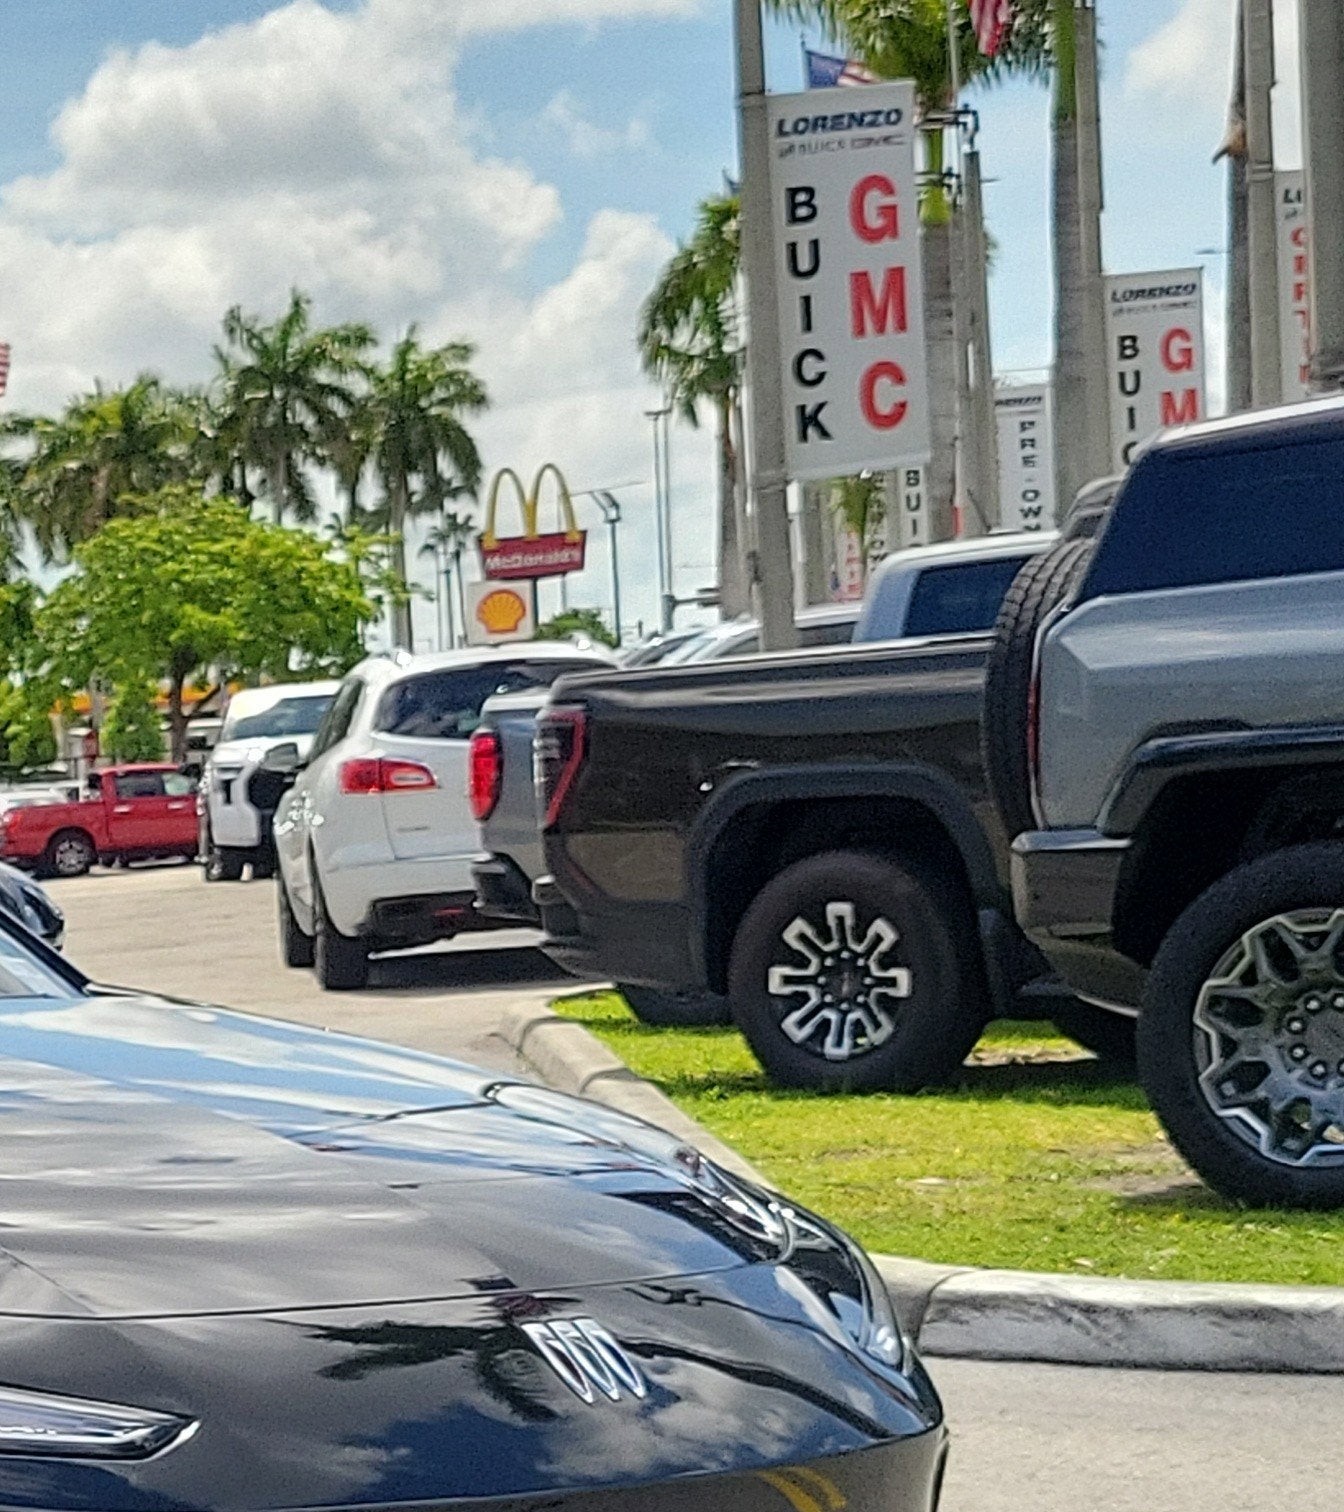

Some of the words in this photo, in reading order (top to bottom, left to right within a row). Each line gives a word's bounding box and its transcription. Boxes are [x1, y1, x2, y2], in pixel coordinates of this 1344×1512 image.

[777, 108, 903, 137] LORENZO
[785, 186, 833, 443] BUICK
[849, 174, 908, 430] GMC
[1111, 283, 1197, 303] LORENZO
[1117, 335, 1141, 466] BUIC
[1161, 327, 1198, 425] GM
[906, 469, 921, 547] BUI
